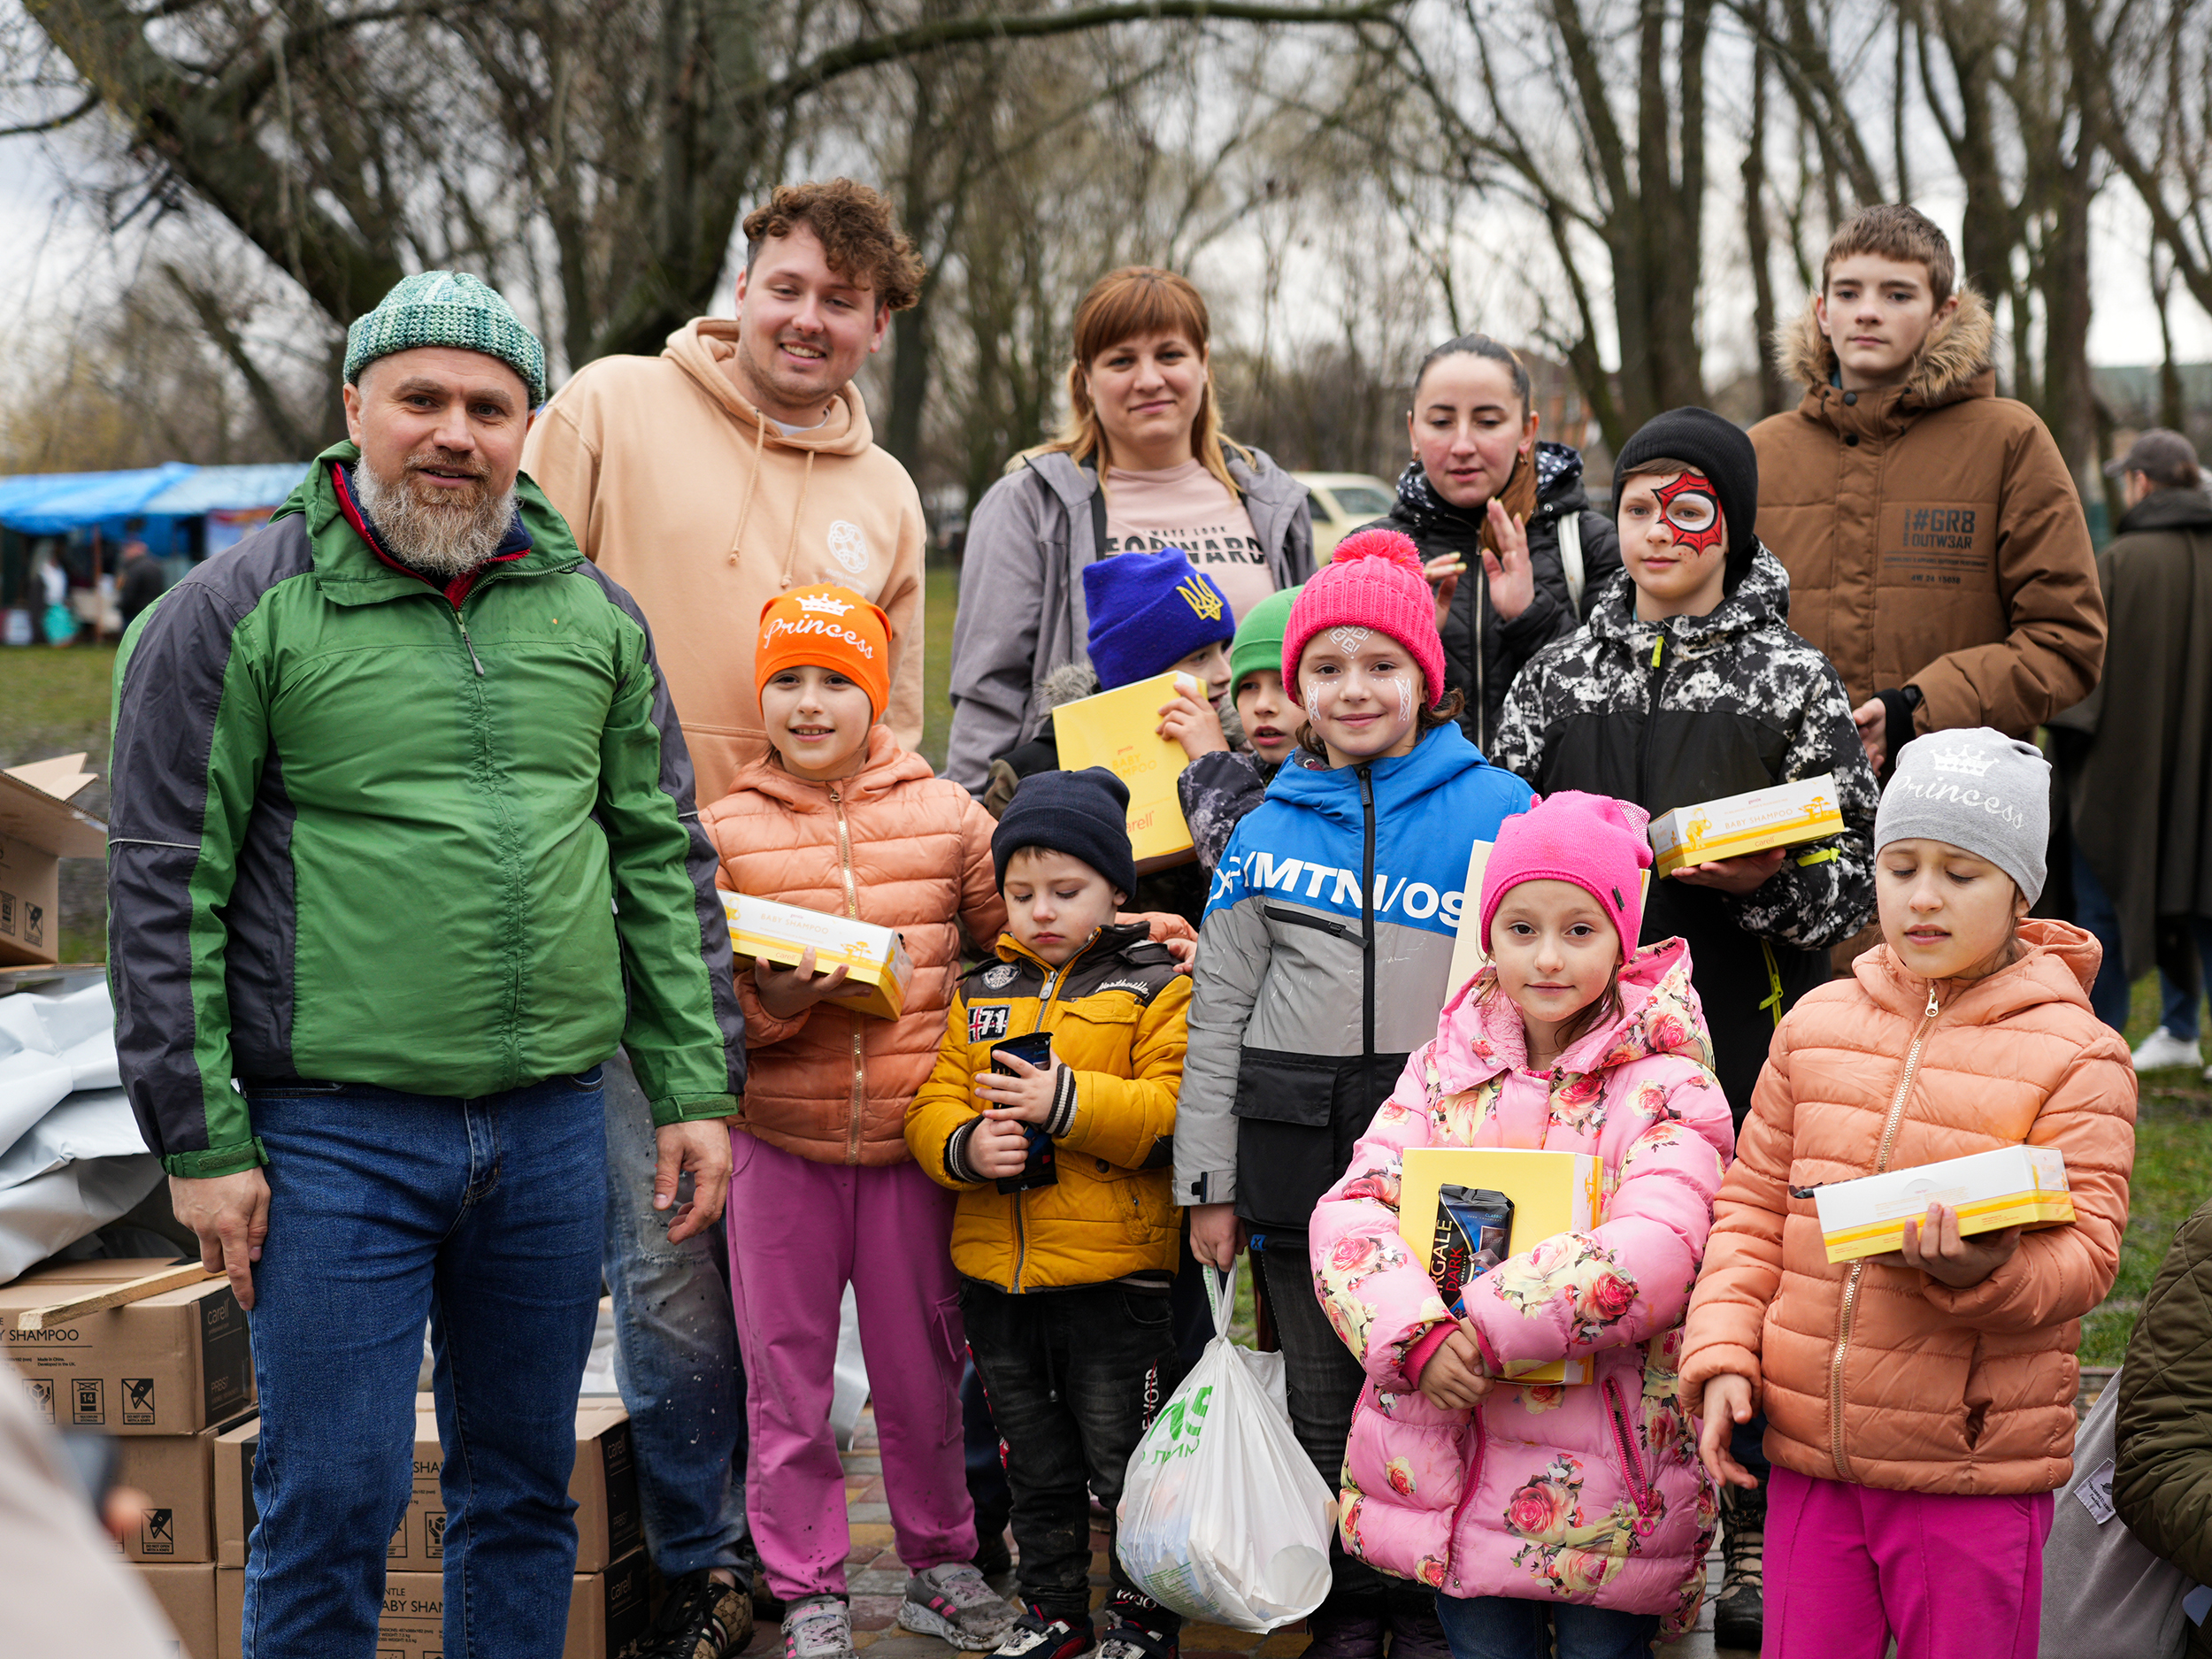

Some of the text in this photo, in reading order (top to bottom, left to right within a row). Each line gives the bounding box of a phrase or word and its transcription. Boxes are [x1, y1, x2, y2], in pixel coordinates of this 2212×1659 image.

[1913, 509, 1976, 534] #GR8
[1912, 534, 1972, 549] OUTW3AR
[764, 613, 874, 660] Princess
[1111, 753, 1141, 771] BABY
[1115, 759, 1157, 780] AMPOO
[1884, 775, 2025, 830] Princess
[1125, 812, 1154, 834] arell
[1724, 808, 1794, 830] BABY SHAMPOO
[1755, 836, 1775, 848] carell
[760, 912, 783, 924] BABY
[785, 918, 829, 935] SHAMPOO
[775, 951, 797, 962] carell
[1430, 1219, 1453, 1293] RGALE
[1445, 1247, 1463, 1292] DARK
[207, 1298, 229, 1325] carell
[9, 1329, 80, 1341] SHAMPOO
[81, 1394, 94, 1402] 14
[385, 1587, 406, 1596] NTLE
[611, 1570, 633, 1601] carell
[382, 1600, 407, 1612] ABY
